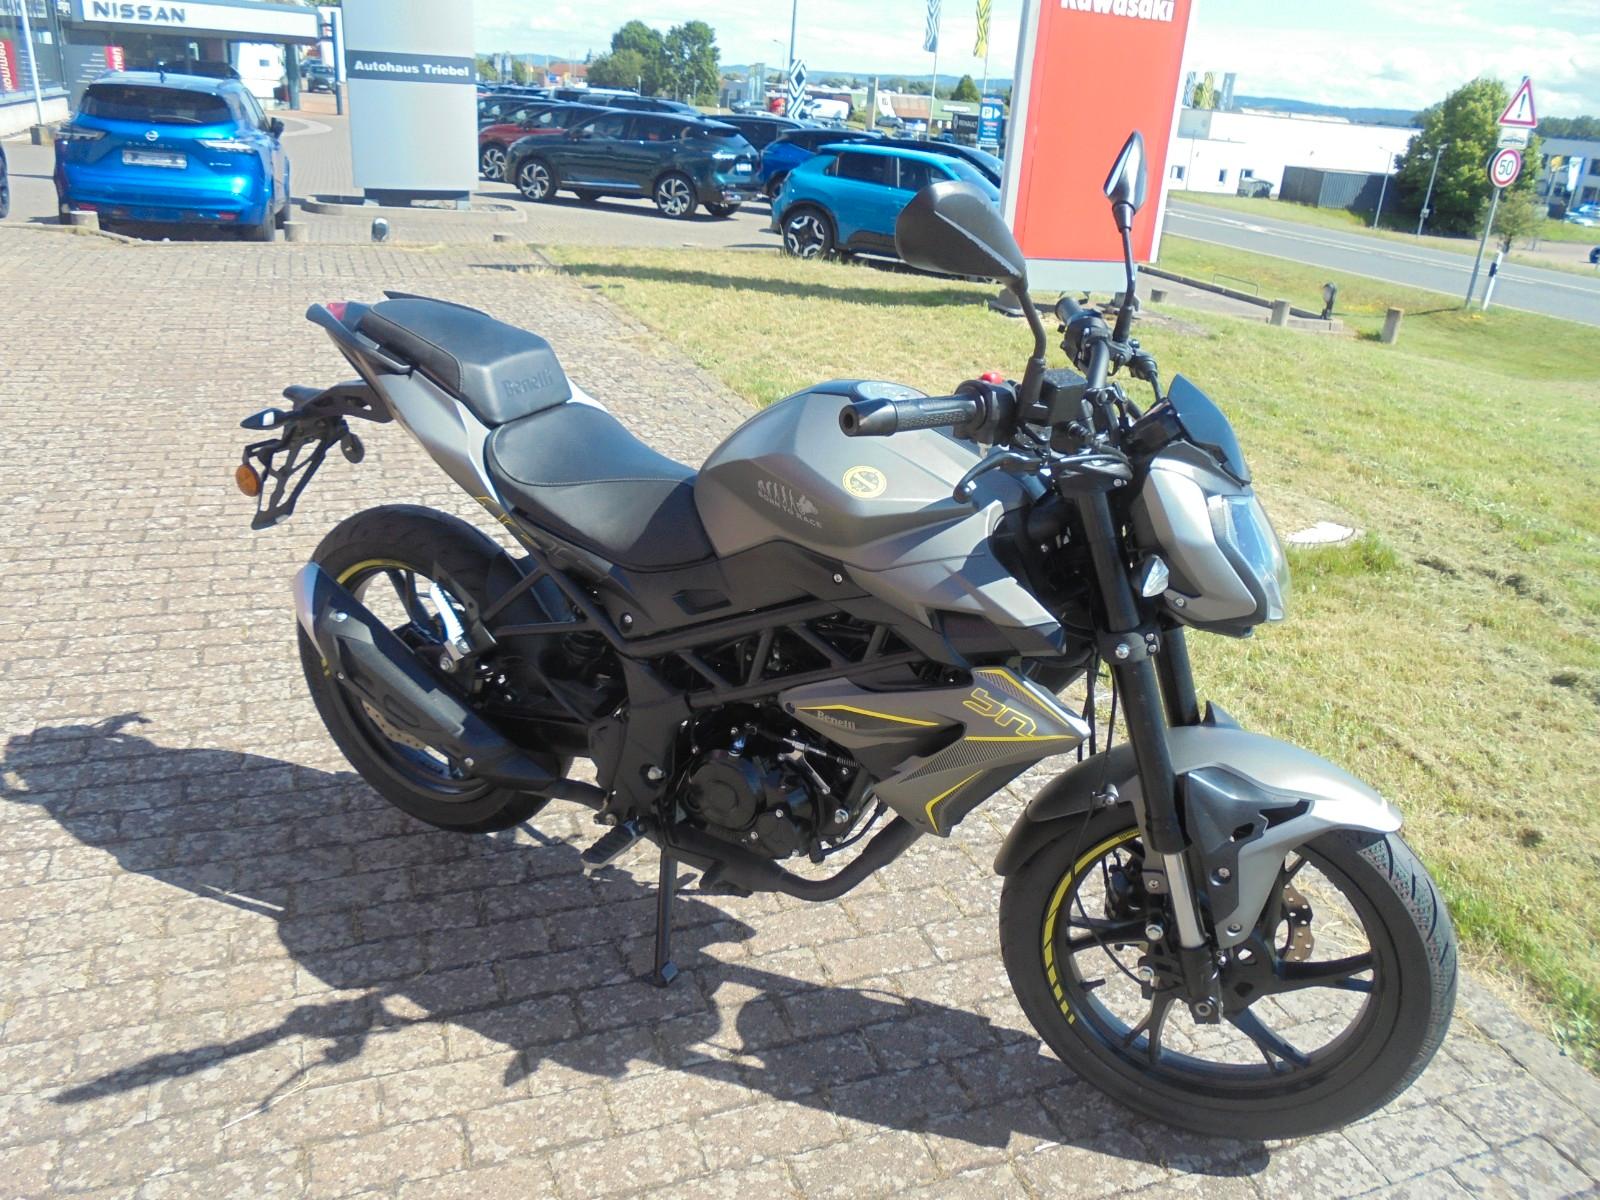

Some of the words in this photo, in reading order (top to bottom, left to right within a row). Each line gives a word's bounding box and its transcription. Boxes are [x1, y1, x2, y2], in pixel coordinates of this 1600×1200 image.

[93, 1, 185, 23] NISSAN
[354, 60, 420, 74] Autohaus
[422, 63, 470, 77] Triebel
[1497, 159, 1514, 177] 50
[502, 369, 553, 397] Benelli
[816, 709, 856, 732] Benelli
